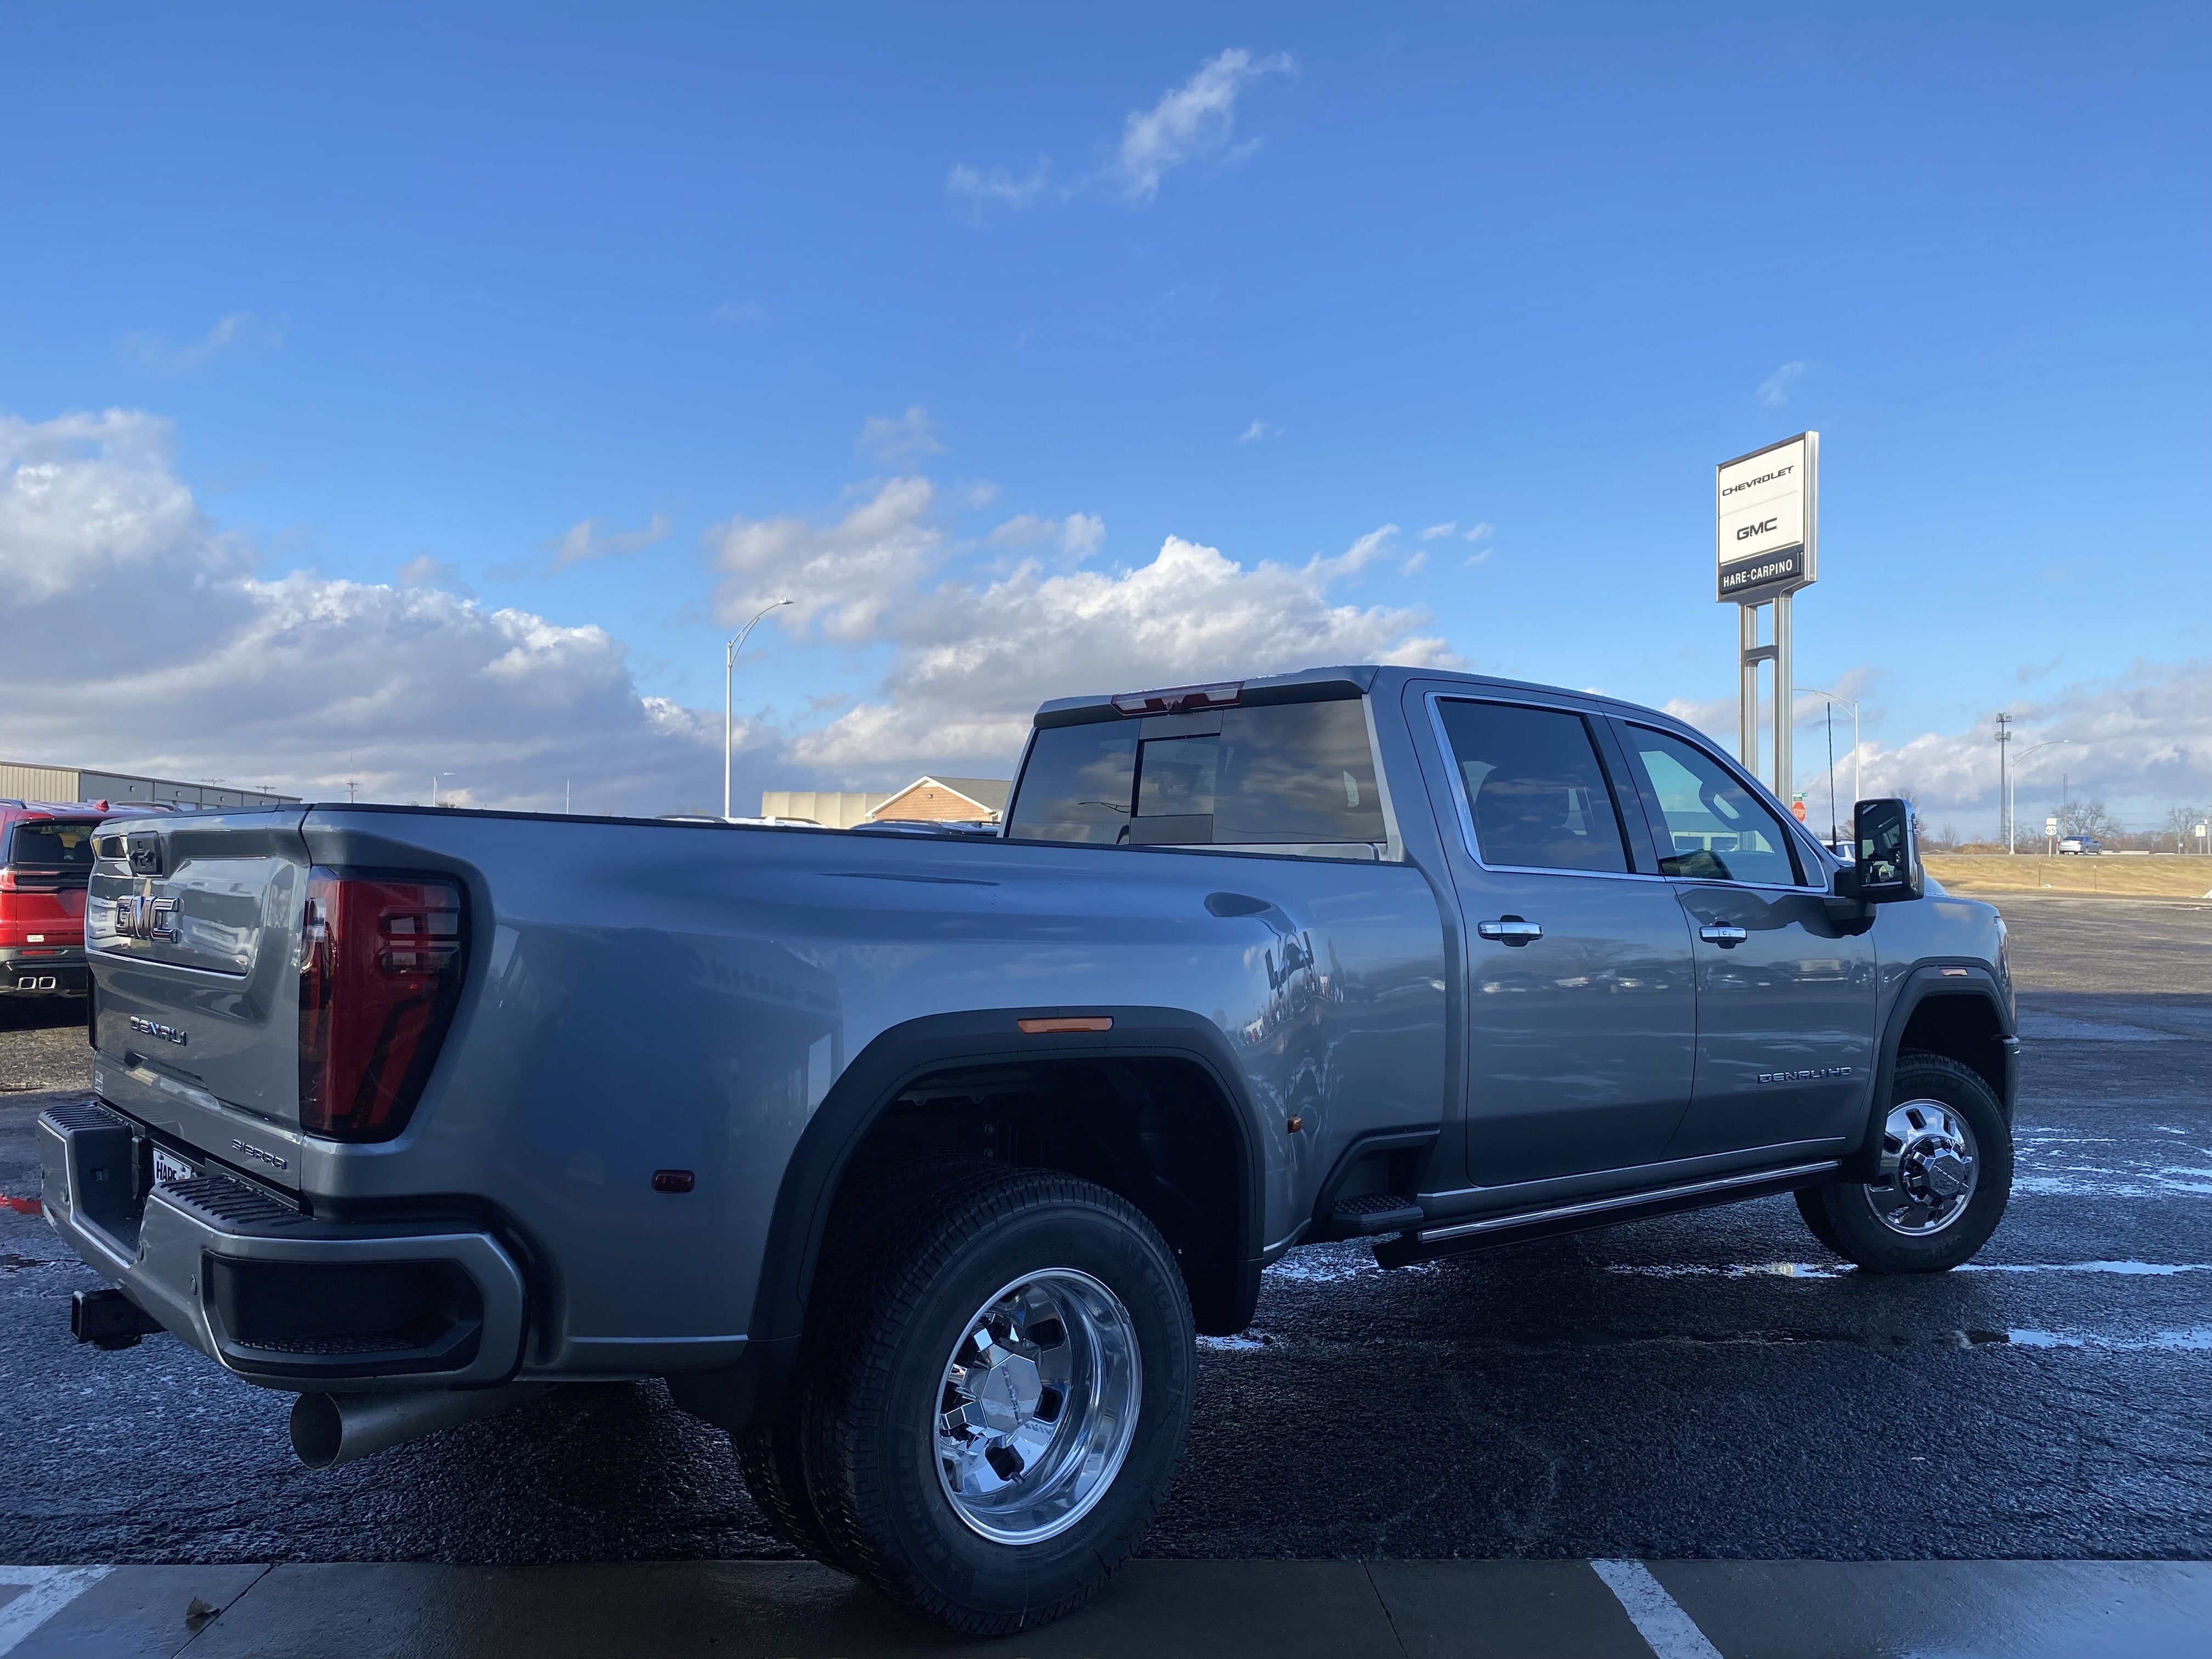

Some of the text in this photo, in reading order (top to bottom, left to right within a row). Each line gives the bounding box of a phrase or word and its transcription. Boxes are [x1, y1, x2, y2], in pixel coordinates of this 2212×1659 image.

[1722, 465, 1794, 496] CHEVROLET
[1736, 517, 1778, 541] GMC
[1723, 558, 1792, 588] HARE-CARPINO
[1793, 809, 1805, 817] STOP
[116, 894, 183, 944] GMC
[131, 1015, 187, 1046] DENALI
[1758, 1066, 1852, 1084] DENALI HD
[232, 1138, 287, 1170] SIERRA
